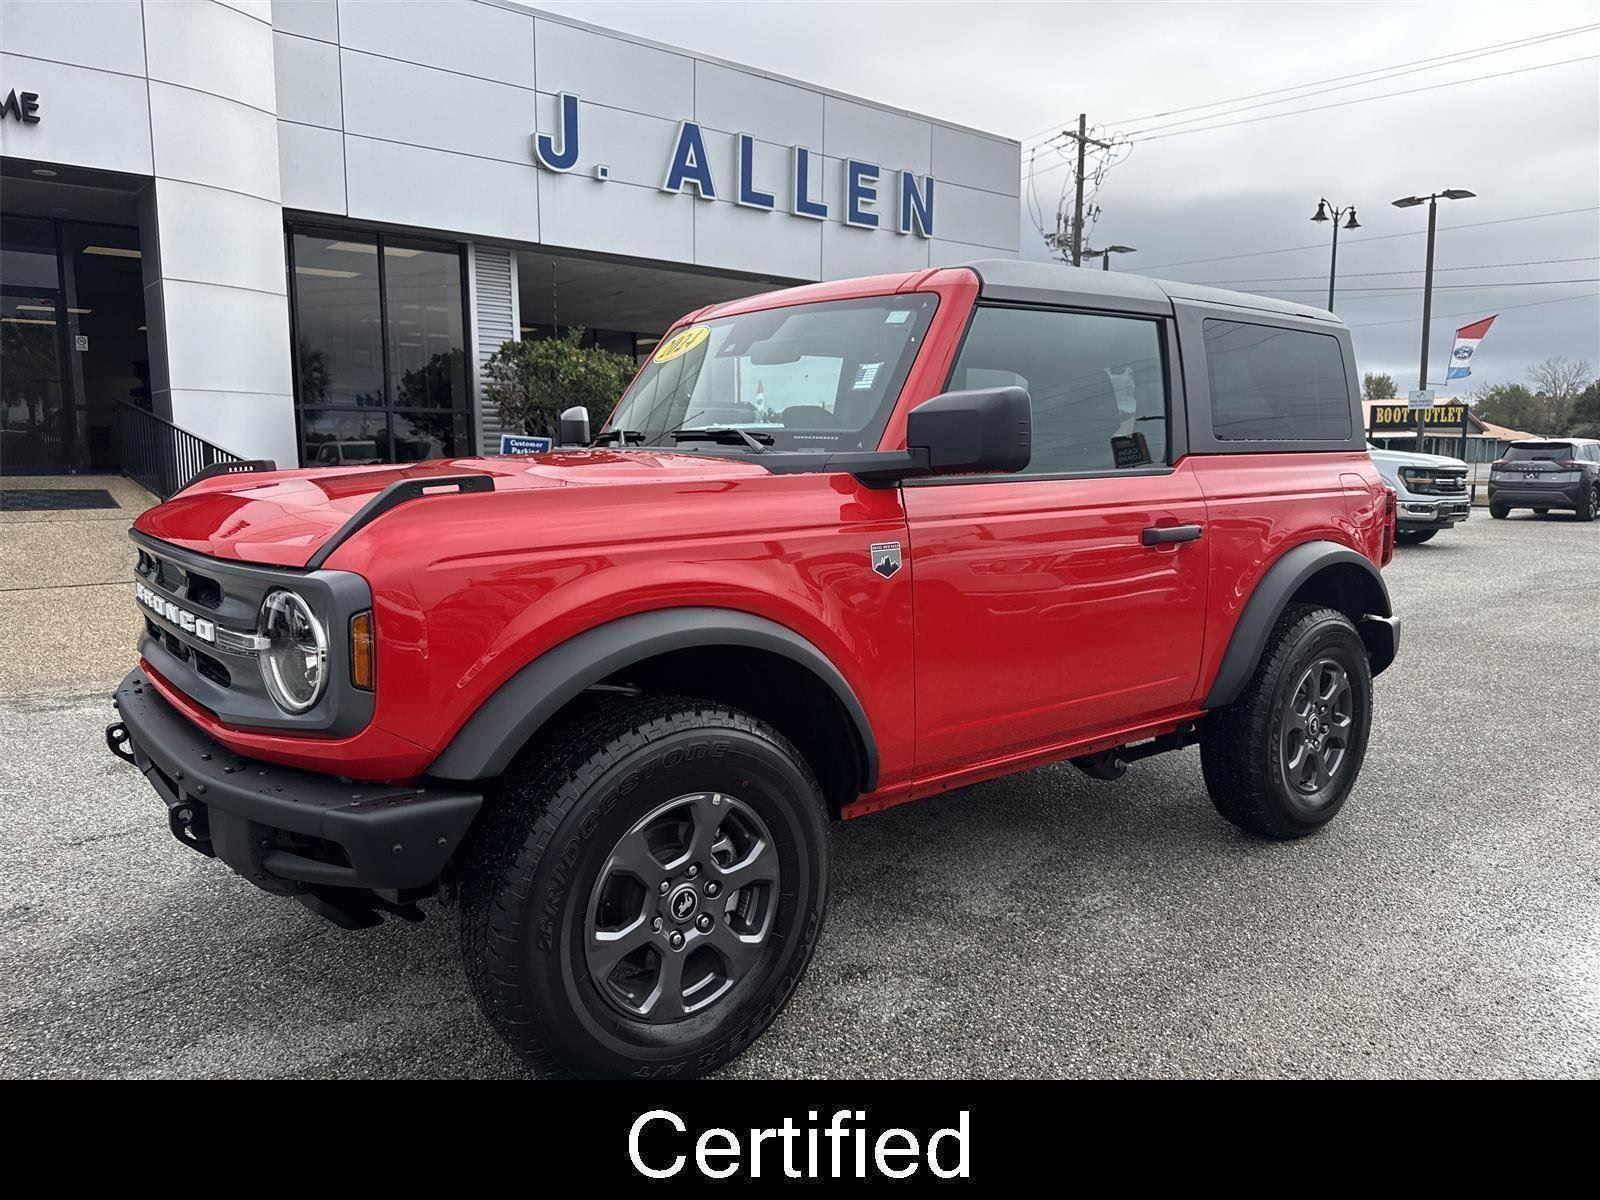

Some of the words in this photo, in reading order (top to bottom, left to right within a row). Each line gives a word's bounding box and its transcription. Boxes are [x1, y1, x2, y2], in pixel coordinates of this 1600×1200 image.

[660, 119, 935, 239] ALLEN
[657, 328, 705, 360] 2024
[1375, 407, 1410, 424] BOOT
[510, 439, 544, 448] Customer
[136, 582, 215, 642] BRONCO
[537, 740, 731, 953] BRIDGESTONE
